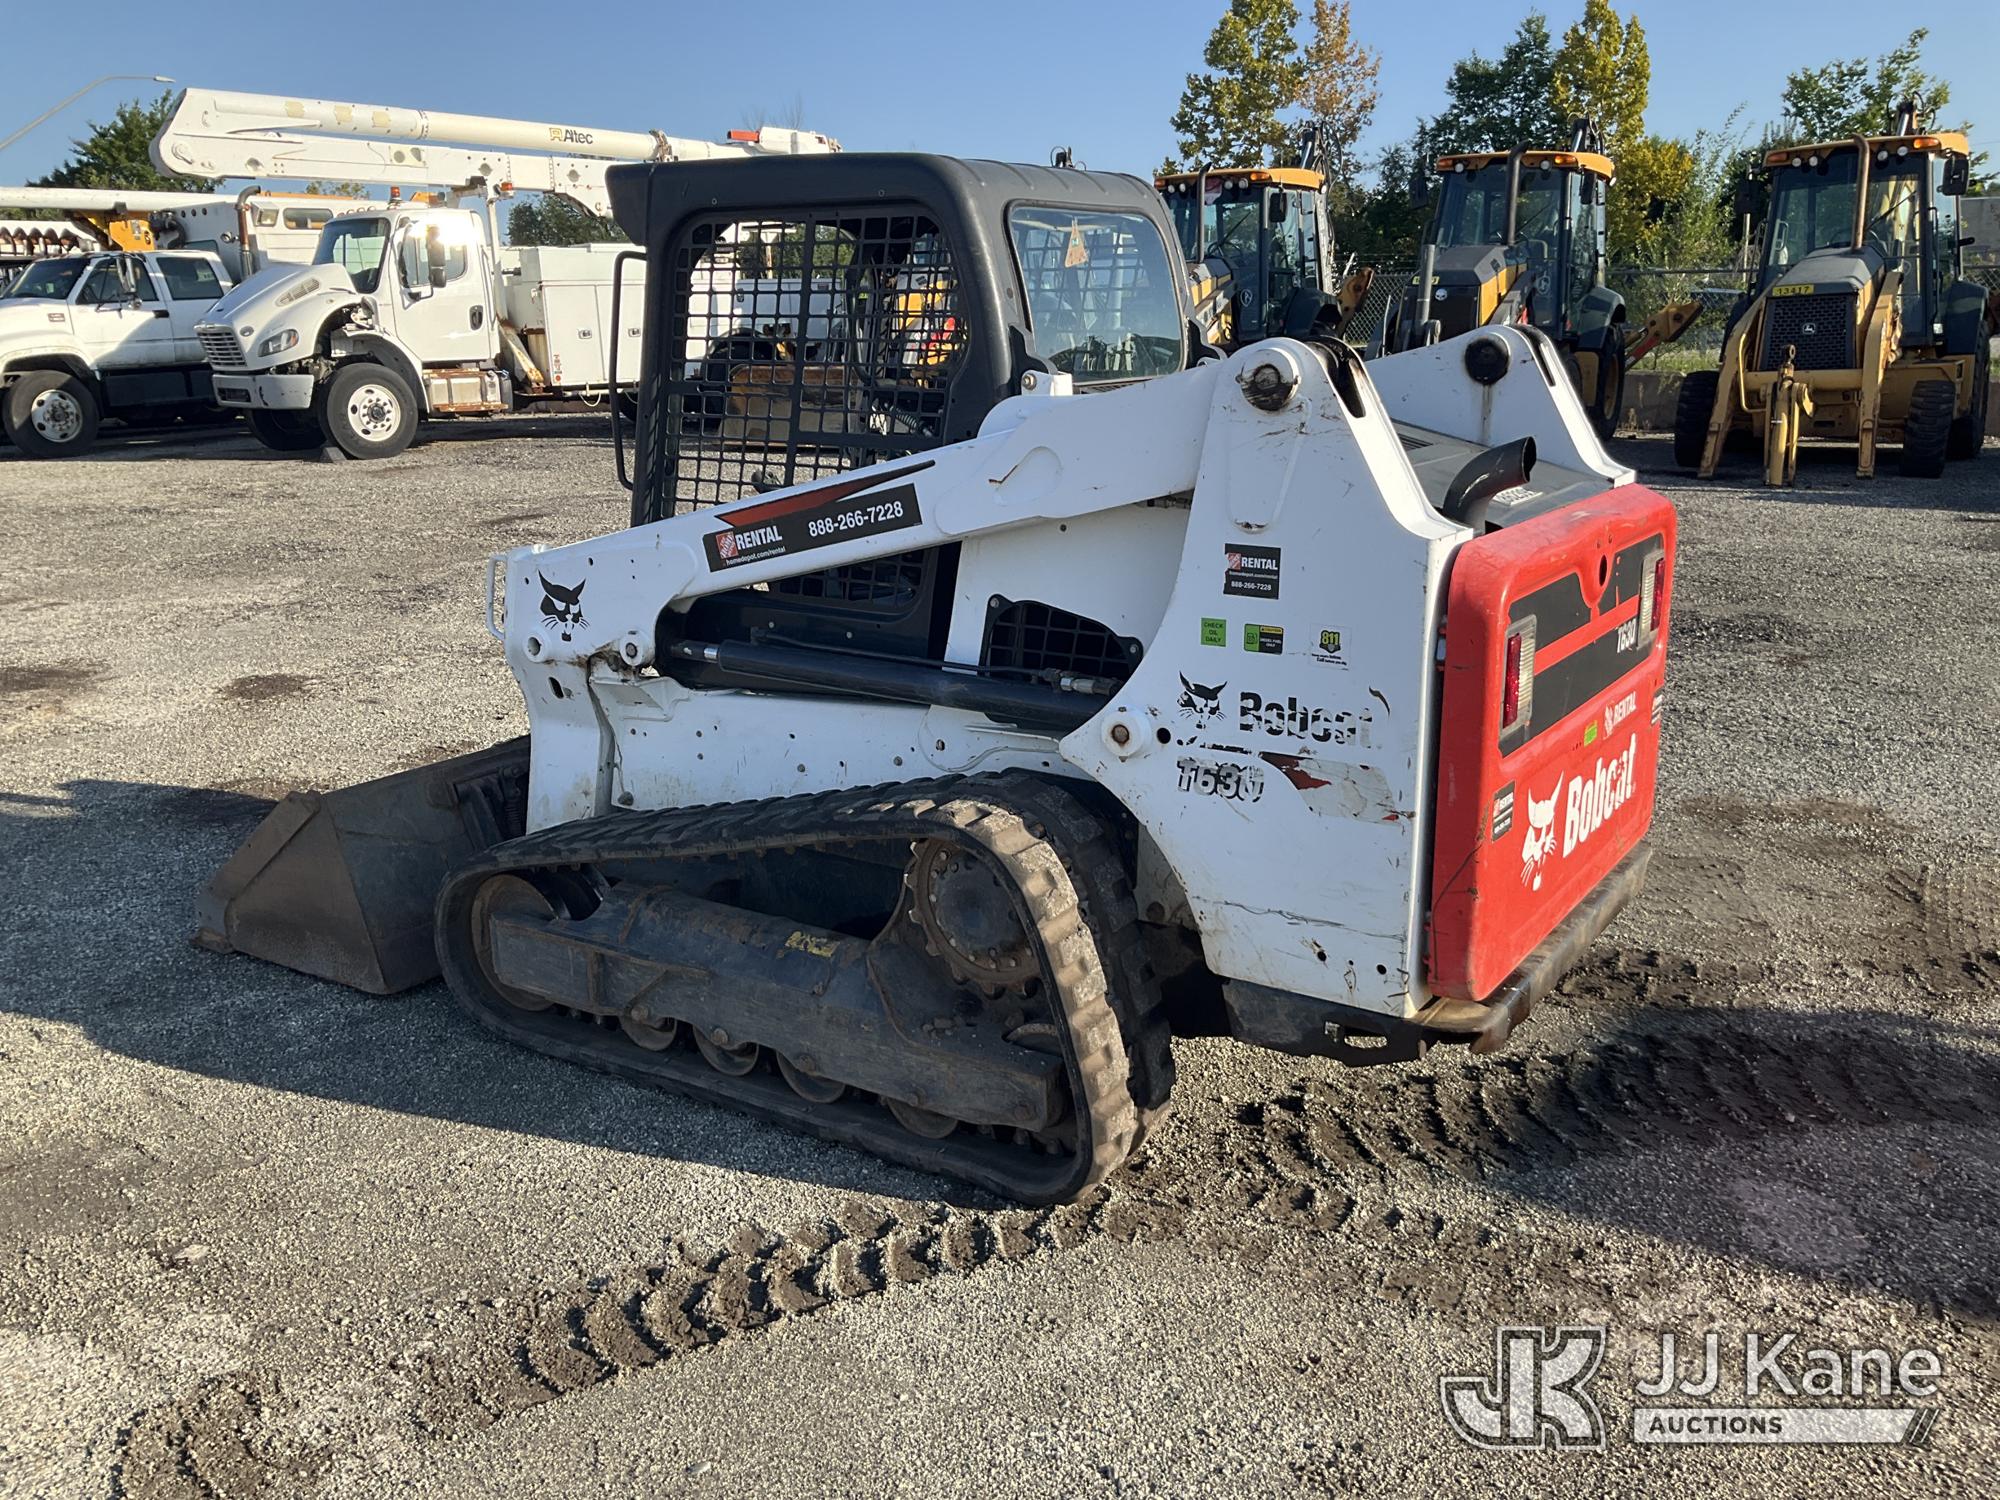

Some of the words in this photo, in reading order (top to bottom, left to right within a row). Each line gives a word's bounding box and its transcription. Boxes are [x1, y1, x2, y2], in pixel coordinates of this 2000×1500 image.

[564, 129, 593, 145] Altec
[808, 501, 904, 537] 888-266-7228
[735, 525, 783, 550] RENTAL
[726, 546, 786, 565] homedepot.com/rental
[1241, 556, 1278, 570] RENTAL
[1204, 621, 1223, 629] CHECK
[1321, 630, 1339, 645] 811
[1616, 617, 1637, 653] T630
[1563, 733, 1637, 858] Bobcat
